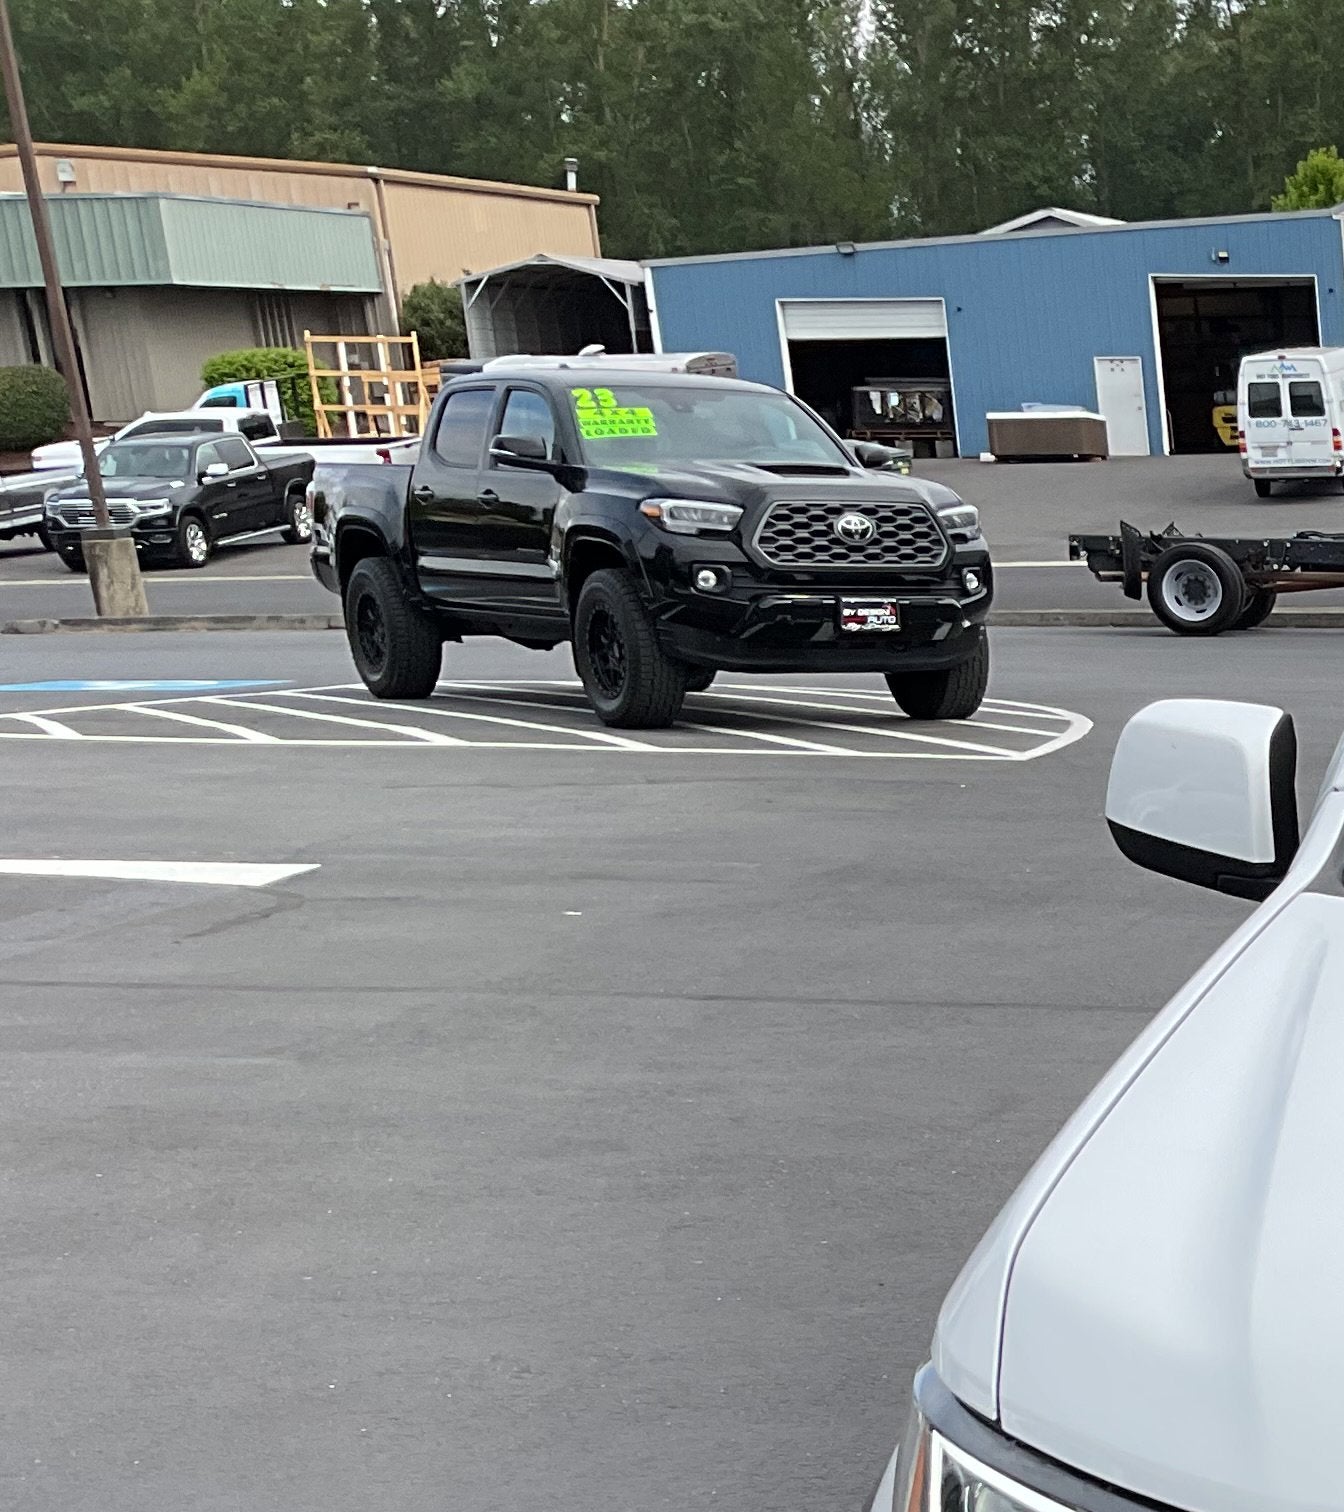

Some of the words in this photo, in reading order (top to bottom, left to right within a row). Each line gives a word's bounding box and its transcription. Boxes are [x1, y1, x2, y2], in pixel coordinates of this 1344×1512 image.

[571, 388, 618, 408] 23
[581, 418, 650, 426] WARRANTY
[585, 427, 651, 437] LOADED
[867, 615, 897, 624] AUTO
